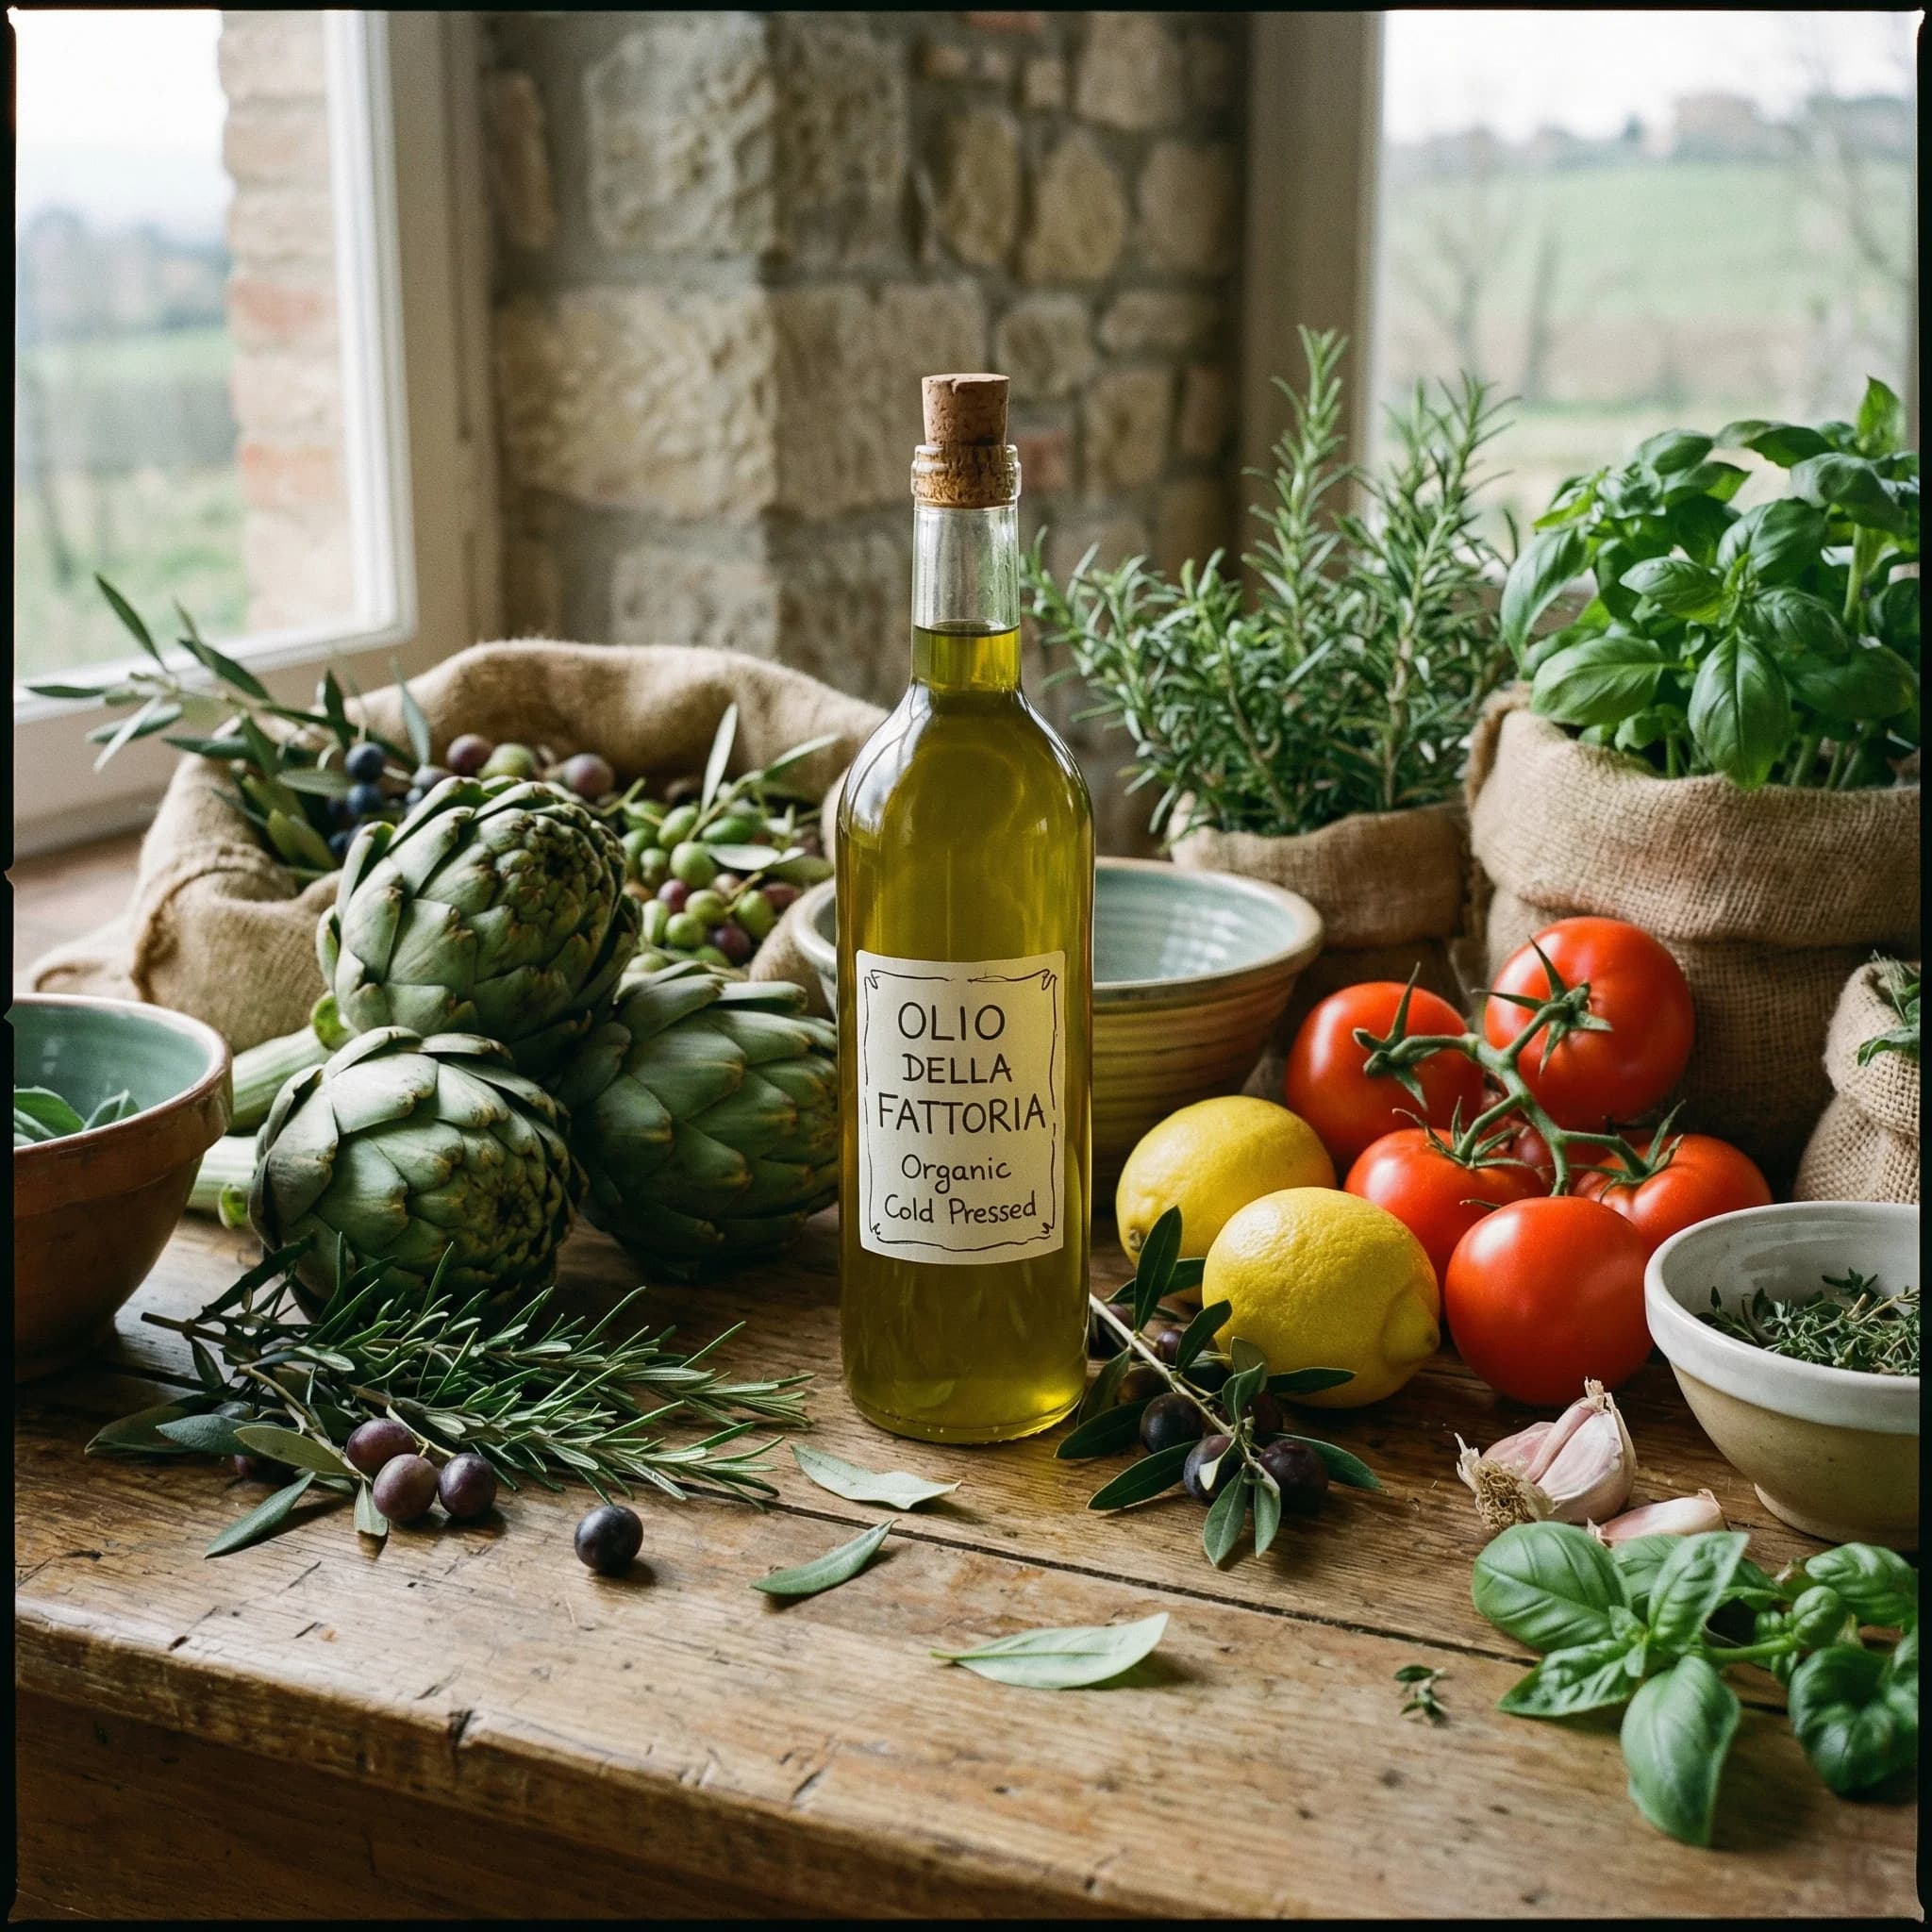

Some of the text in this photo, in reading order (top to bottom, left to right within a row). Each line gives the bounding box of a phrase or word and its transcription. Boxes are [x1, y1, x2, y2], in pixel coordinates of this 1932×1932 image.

[897, 1001, 1006, 1041] OLIO
[902, 1053, 1013, 1085] DELLA
[877, 1091, 1046, 1135] FATTORIA
[901, 1153, 1012, 1194] Organic
[884, 1190, 1037, 1224] Cold Pressed
